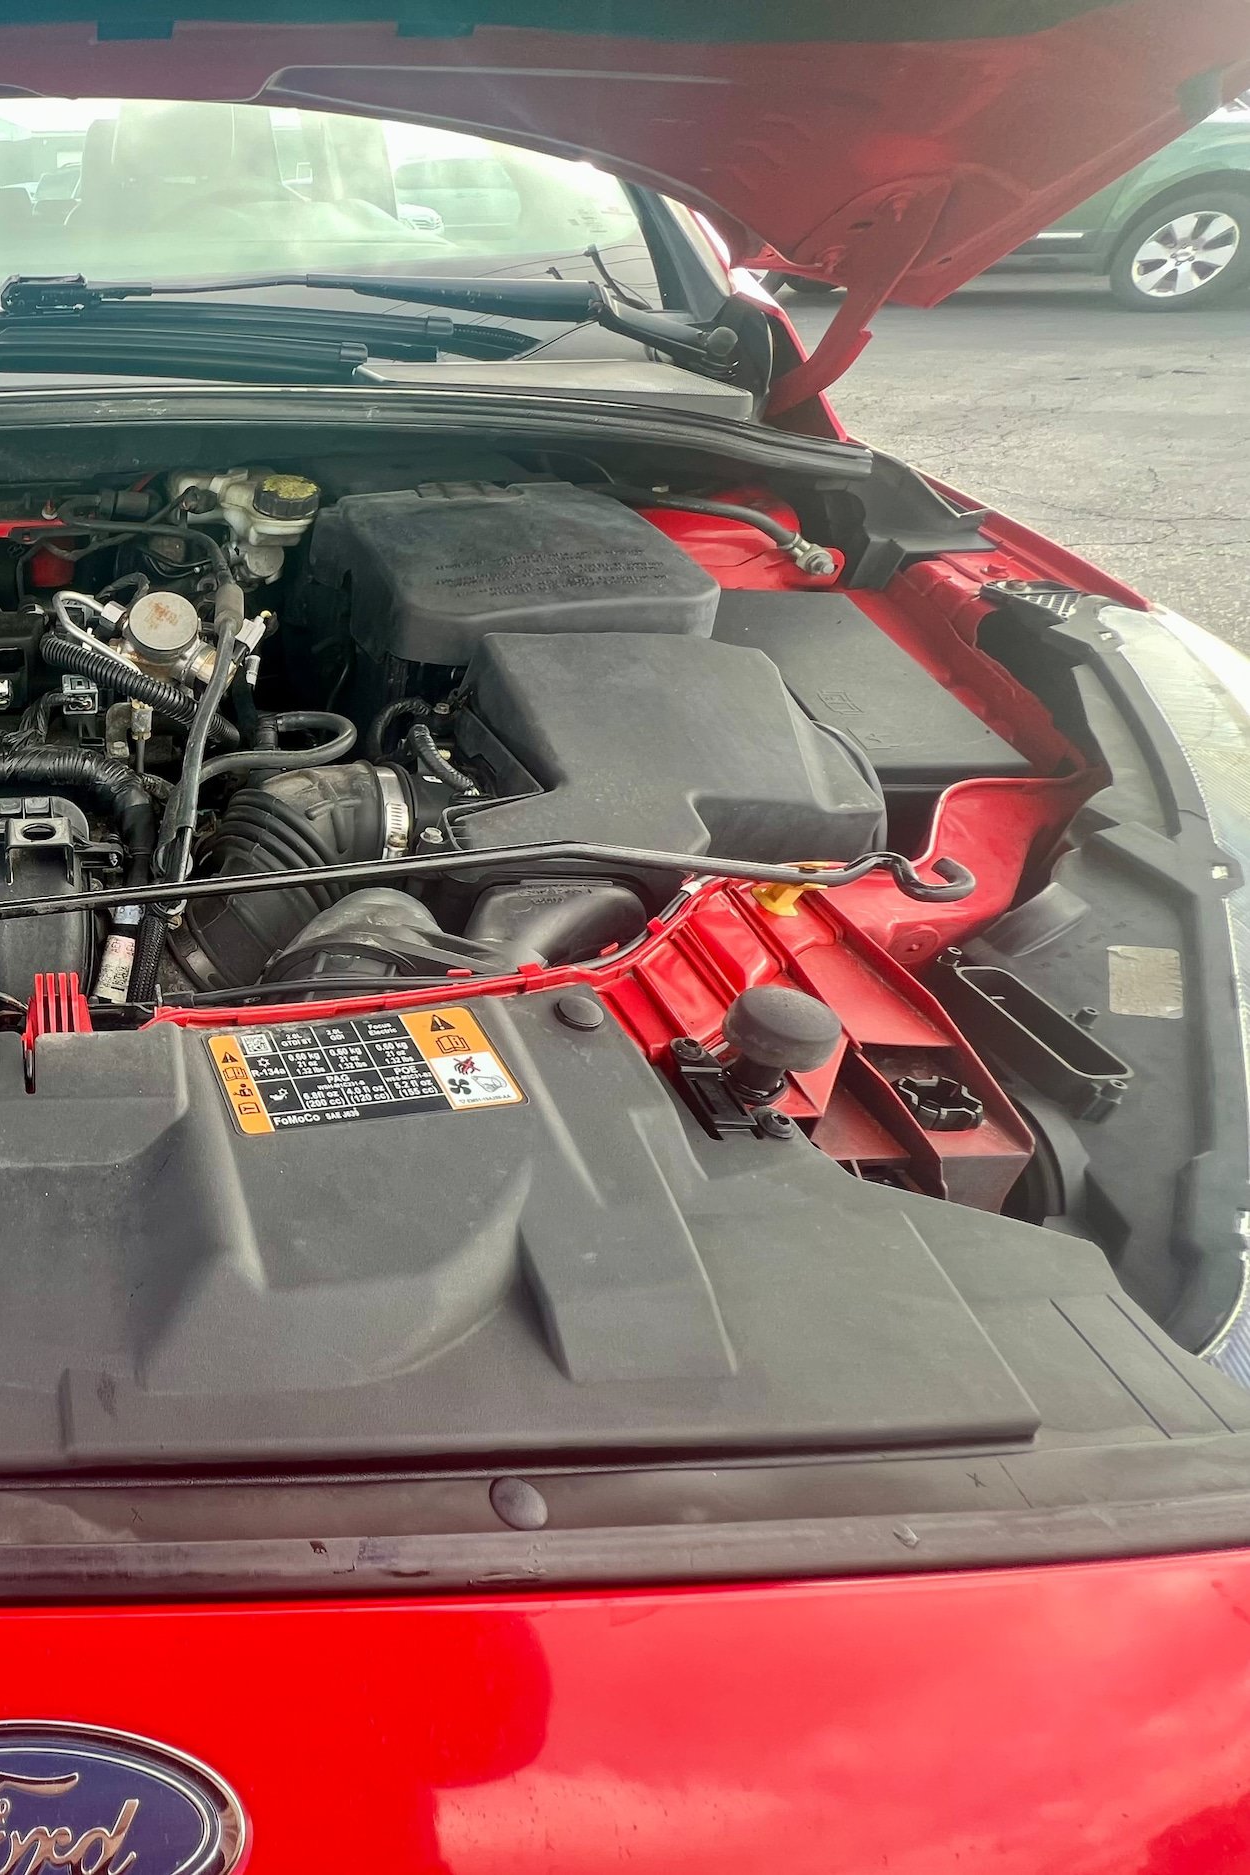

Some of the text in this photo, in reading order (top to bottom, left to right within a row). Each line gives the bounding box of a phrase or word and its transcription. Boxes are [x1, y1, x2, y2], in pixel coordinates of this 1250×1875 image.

[367, 1022, 392, 1030] Focus
[368, 1027, 398, 1036] Electric
[374, 1041, 409, 1051] 0.60 kg
[329, 1046, 363, 1057] 0.60 kg
[385, 1050, 396, 1058] 21
[287, 1052, 321, 1062] 0.60 kg
[338, 1055, 349, 1063] 21
[296, 1060, 307, 1068] 21
[250, 1068, 286, 1078] R-134a
[313, 1066, 326, 1074] lbs
[393, 1066, 419, 1075] POE
[326, 1074, 350, 1084] PAG
[346, 1087, 362, 1095] 4.0
[362, 1085, 371, 1093] fl
[393, 1081, 410, 1090] 5.2
[328, 1089, 340, 1097] oz
[398, 1086, 438, 1098] (155 cc)
[350, 1091, 390, 1104] (120 cc)
[305, 1097, 346, 1110] (200 cc)
[273, 1113, 321, 1126] FoMoCo
